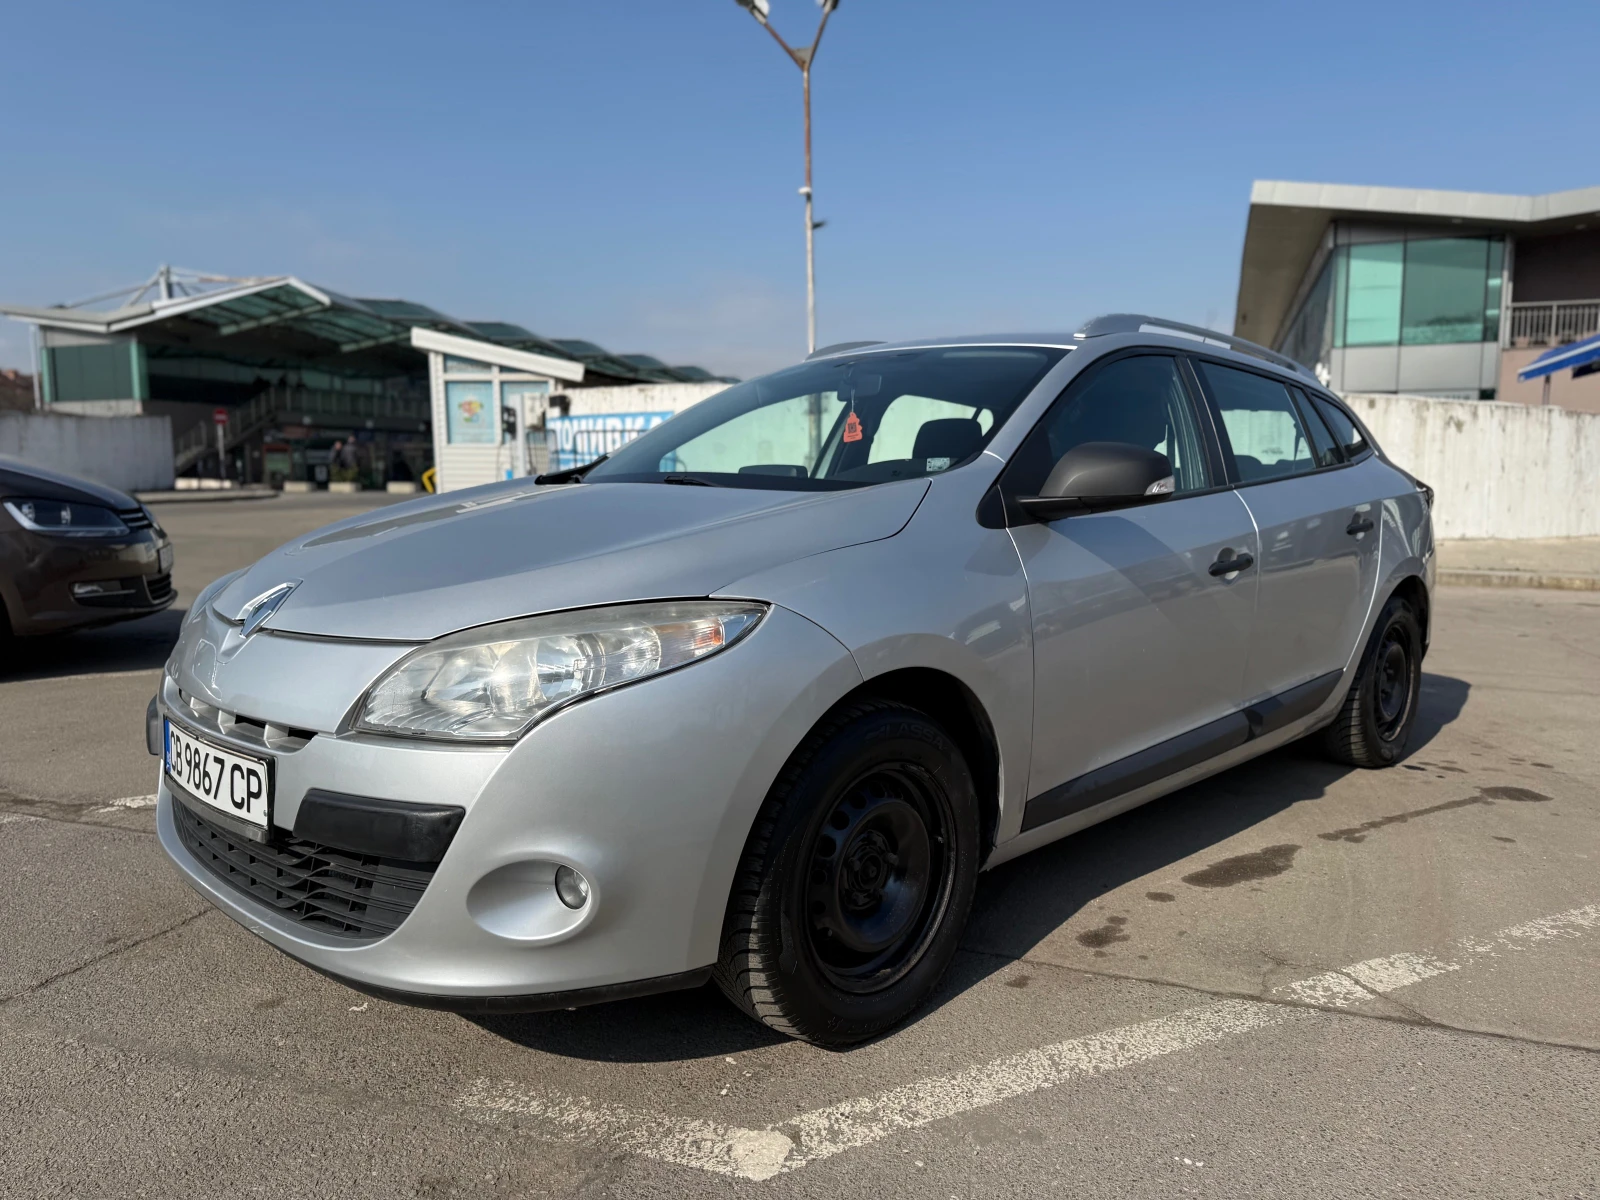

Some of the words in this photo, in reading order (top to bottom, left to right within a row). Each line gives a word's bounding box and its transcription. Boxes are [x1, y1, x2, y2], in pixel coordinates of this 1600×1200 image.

[170, 731, 183, 778] CB
[184, 742, 225, 800] 9867
[230, 763, 262, 813] CP
